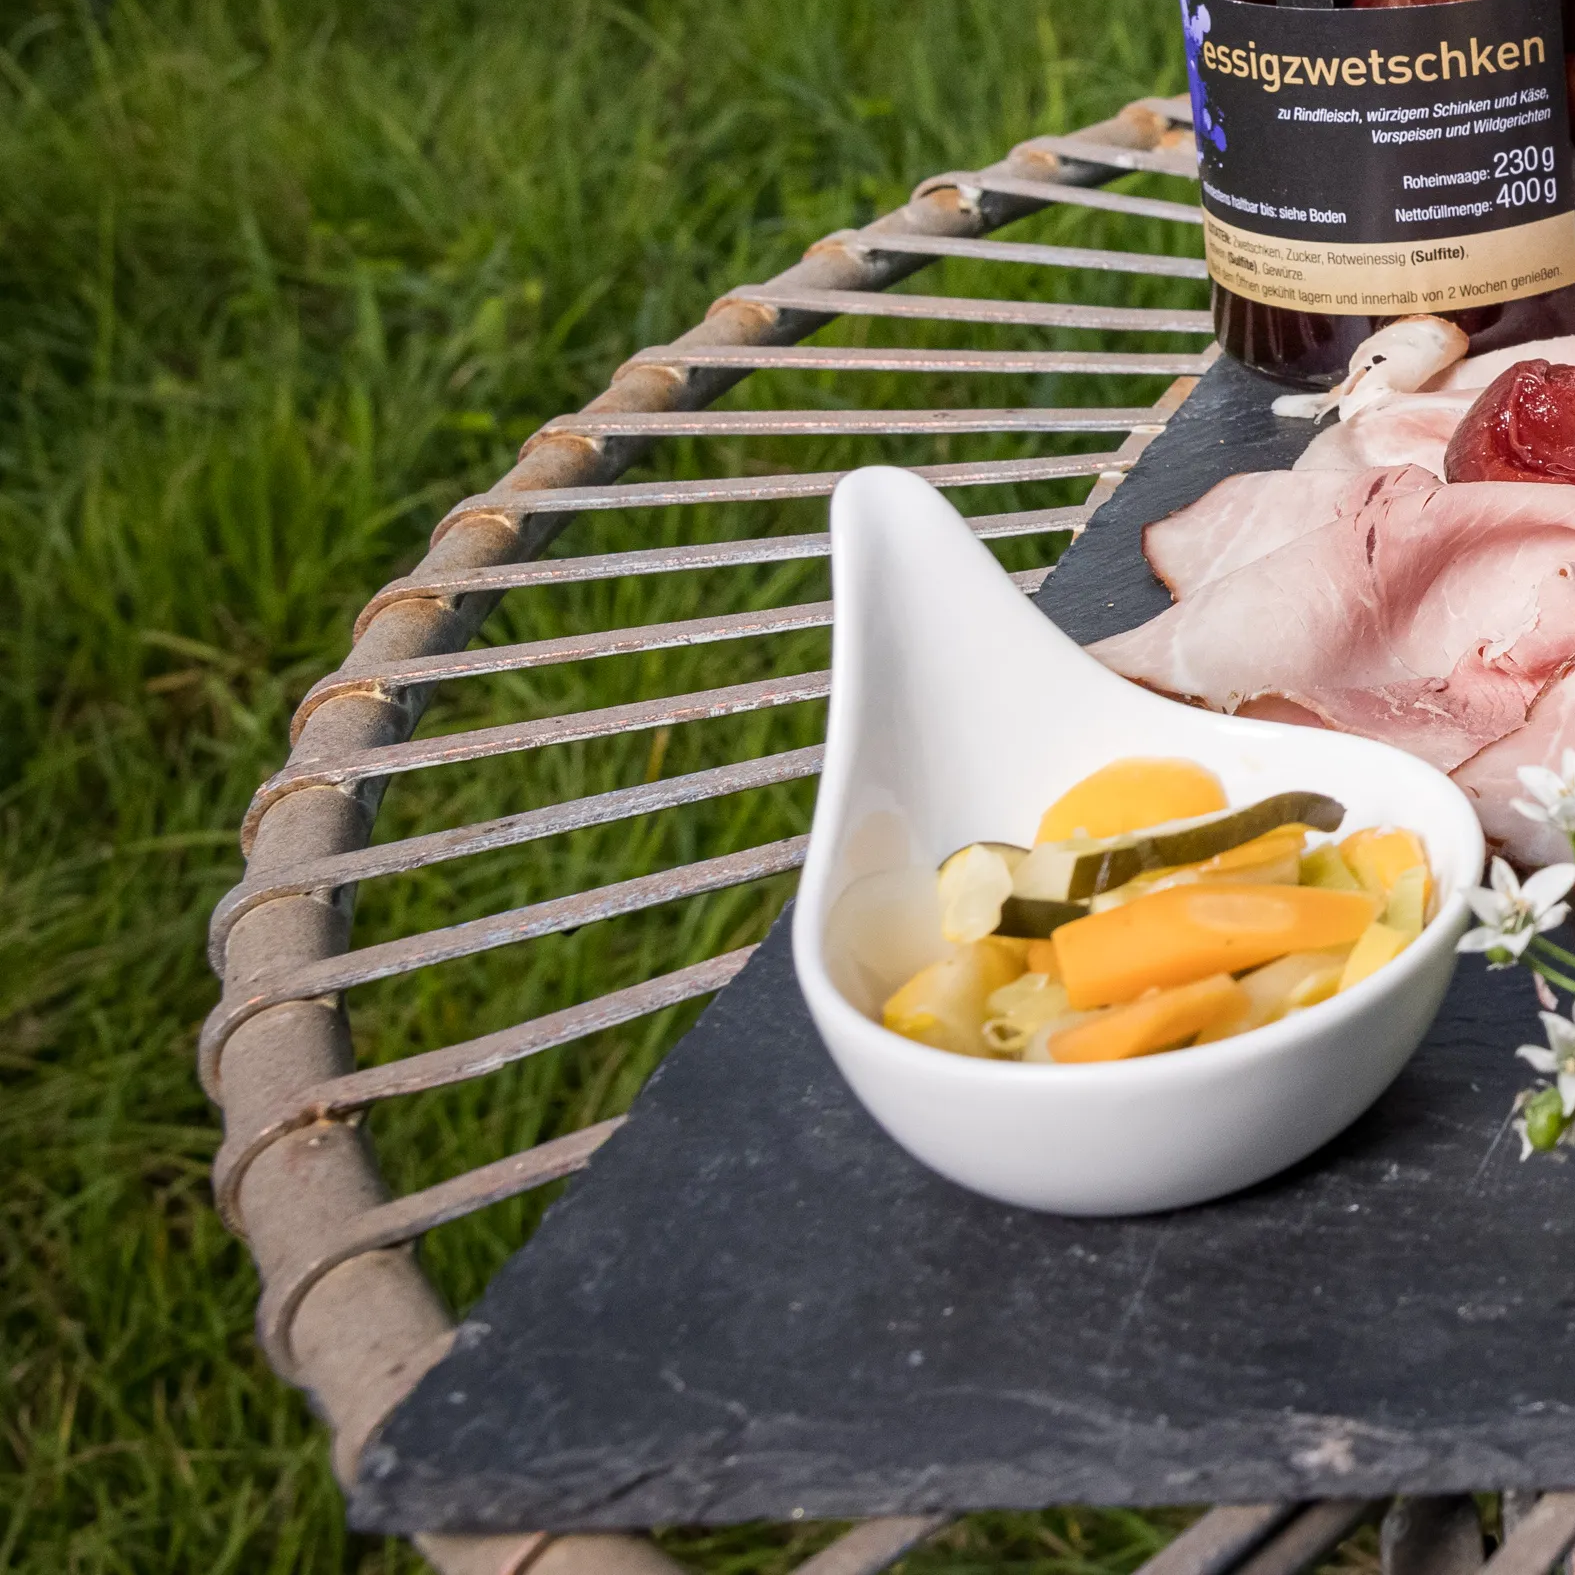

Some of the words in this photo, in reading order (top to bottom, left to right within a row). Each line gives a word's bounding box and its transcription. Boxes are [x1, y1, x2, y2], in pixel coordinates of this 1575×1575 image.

[1203, 36, 1546, 93] essigzwetschken
[1278, 108, 1291, 121] zu
[1294, 107, 1363, 124] Rindfleisch,
[1367, 106, 1429, 123] würzigem
[1433, 99, 1490, 118] Schinken
[1494, 92, 1517, 110] und
[1519, 87, 1549, 105] Käse,
[1371, 125, 1441, 144] Vorspeisen
[1446, 121, 1470, 138] und
[1473, 107, 1551, 133] Wildgerichten
[1403, 169, 1490, 189] Roheinwaage:
[1260, 202, 1277, 218] bis:
[1279, 206, 1307, 222] siehe
[1309, 208, 1347, 224] Boden
[1395, 201, 1493, 222] Nettofüllmenge:
[1233, 235, 1284, 260] Zwetschken,
[1285, 247, 1324, 265] Zucker,
[1327, 252, 1406, 267] Rotweinessig
[1262, 263, 1306, 281] Gewürze.
[1262, 284, 1295, 300] gekühlt
[1298, 290, 1332, 306] lagern
[1336, 292, 1358, 305] und
[1362, 290, 1418, 305] innerhalb
[1422, 289, 1444, 302] von
[1448, 286, 1456, 299] 2
[1459, 280, 1507, 297] Wochen
[1511, 266, 1562, 290] genießen.
